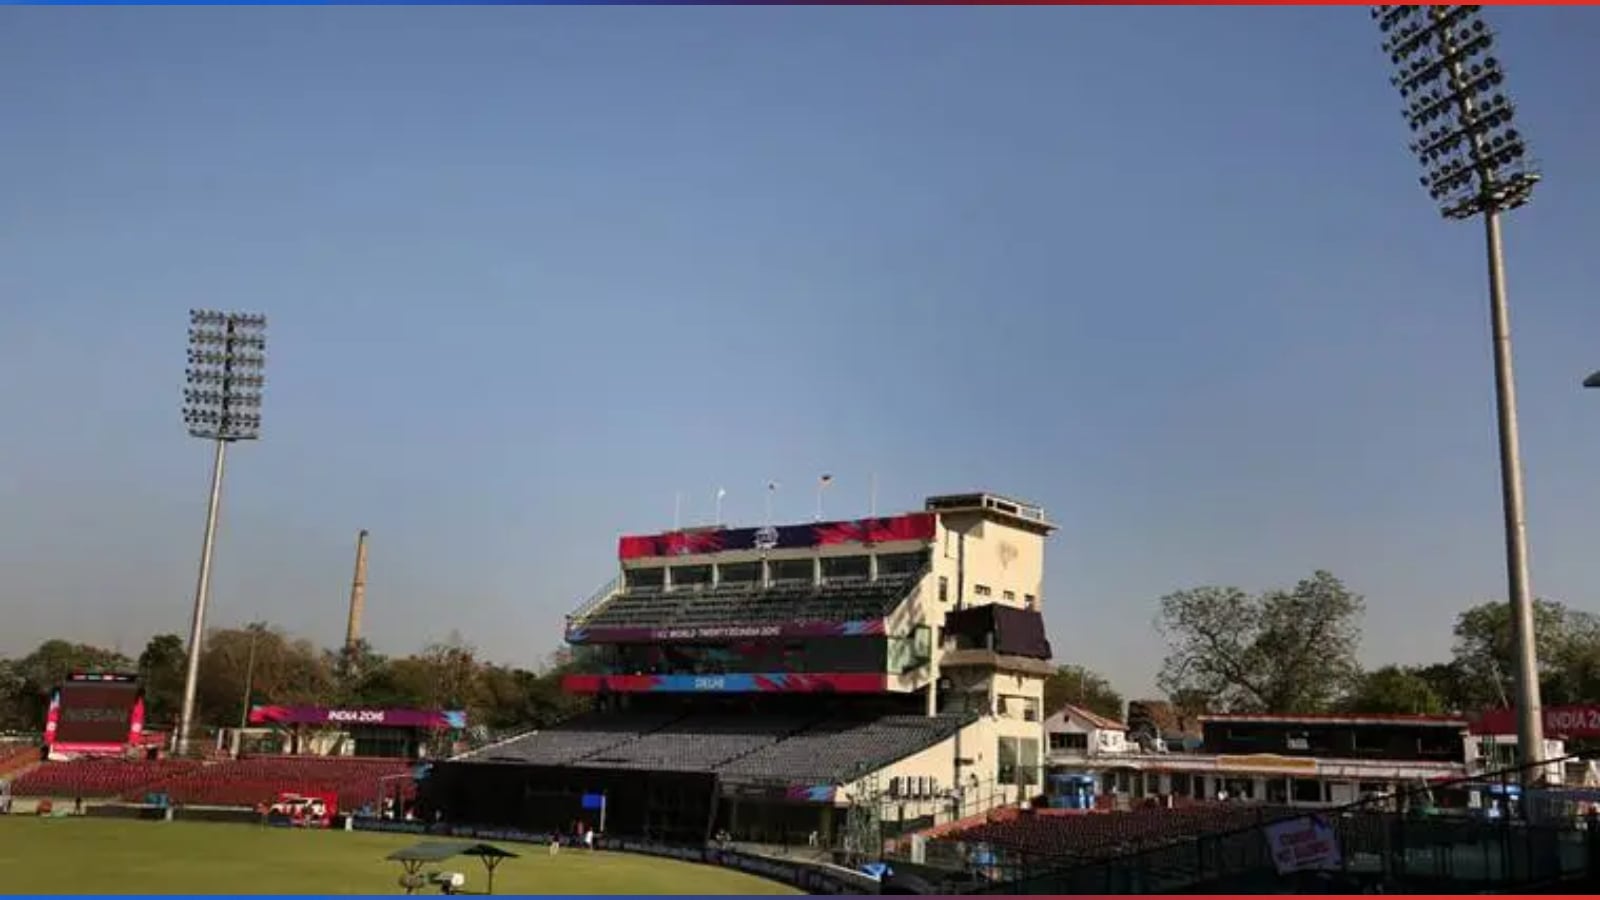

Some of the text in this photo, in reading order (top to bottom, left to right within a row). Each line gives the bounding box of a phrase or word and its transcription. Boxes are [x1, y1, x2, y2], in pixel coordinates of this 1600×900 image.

[670, 629, 696, 638] WORLD
[695, 678, 724, 689] DELHI
[328, 710, 385, 722] INDIA 2016
[1546, 709, 1600, 730] INDIA 2
